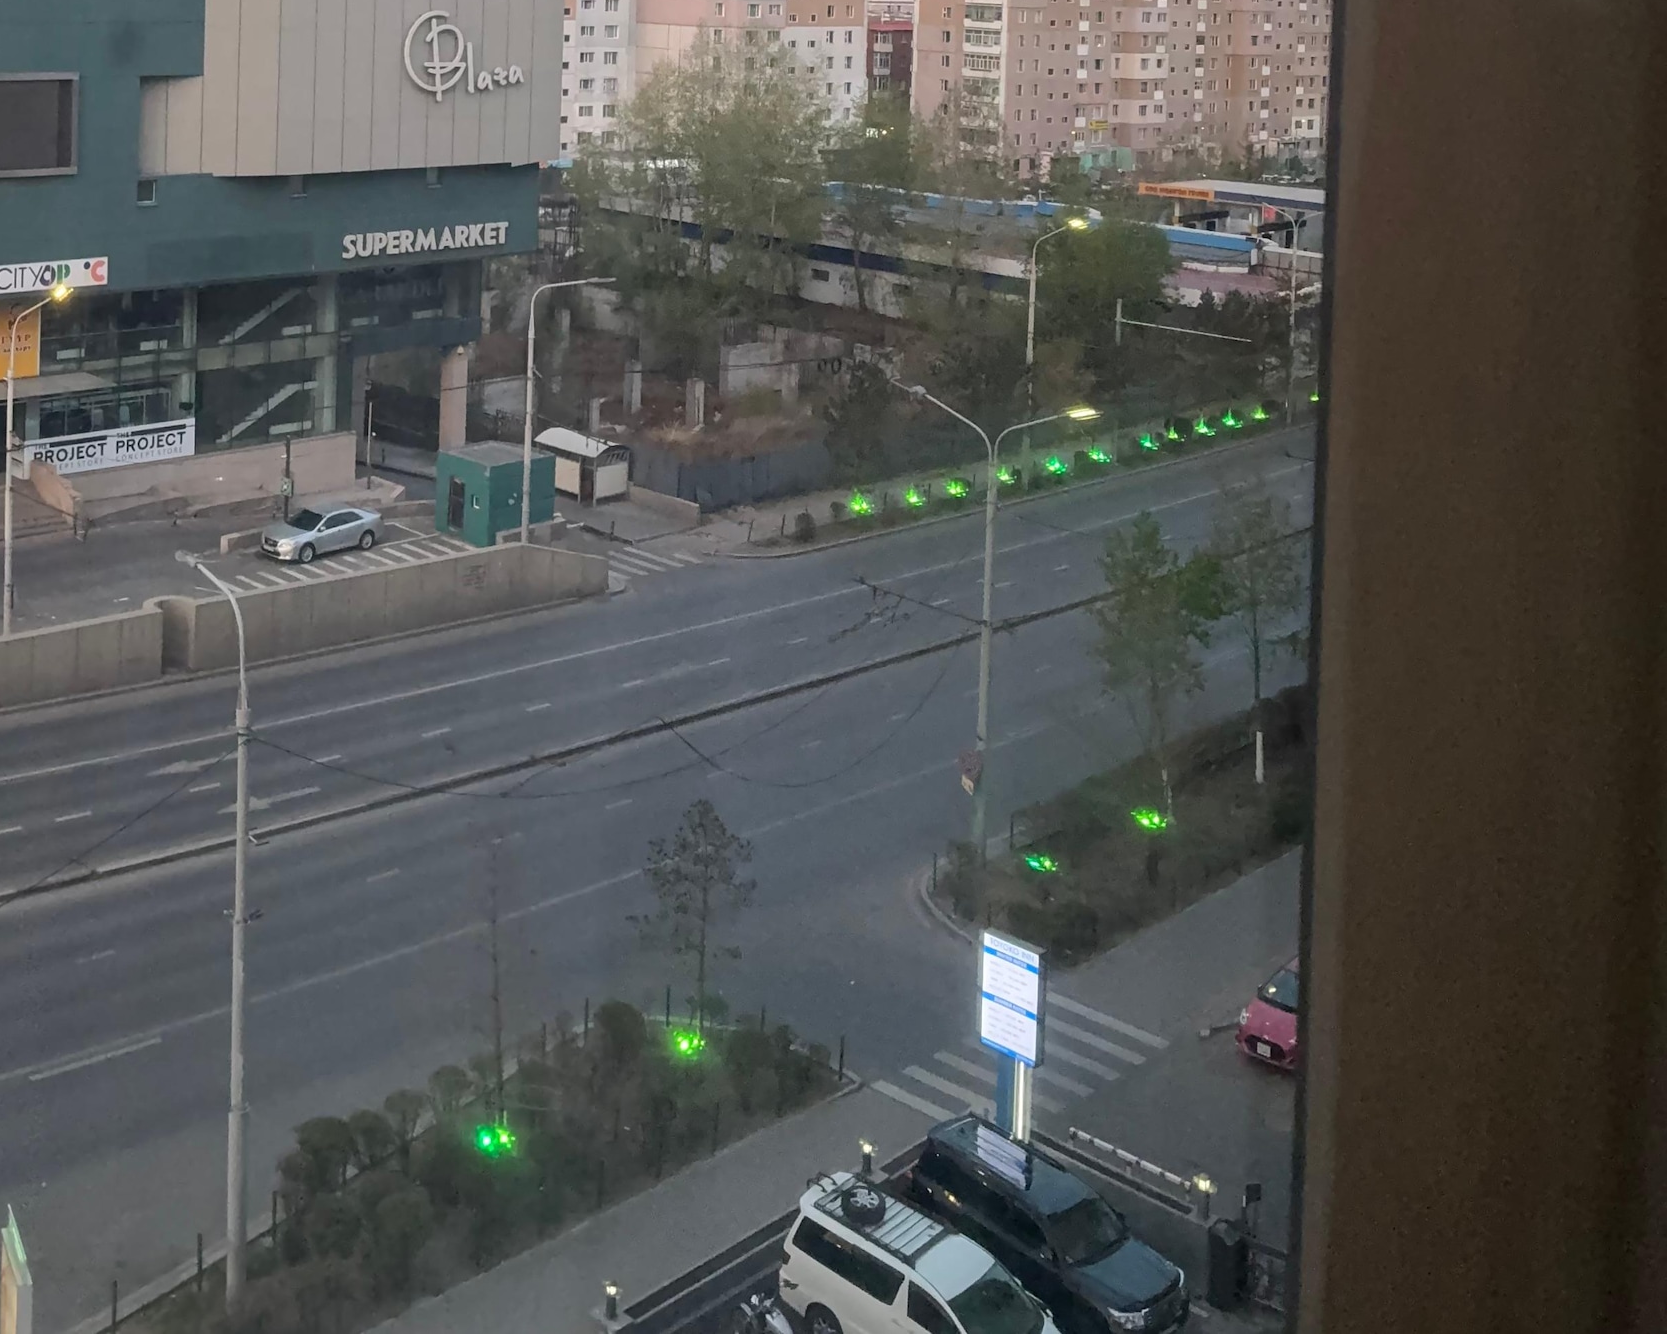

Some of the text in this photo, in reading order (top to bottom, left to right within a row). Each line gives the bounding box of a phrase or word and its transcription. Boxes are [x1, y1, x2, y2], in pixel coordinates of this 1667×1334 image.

[342, 222, 509, 259] SUPERMARKET
[34, 442, 107, 463] PROJECT
[116, 431, 186, 454] PROJECT
[157, 446, 183, 456] STORE
